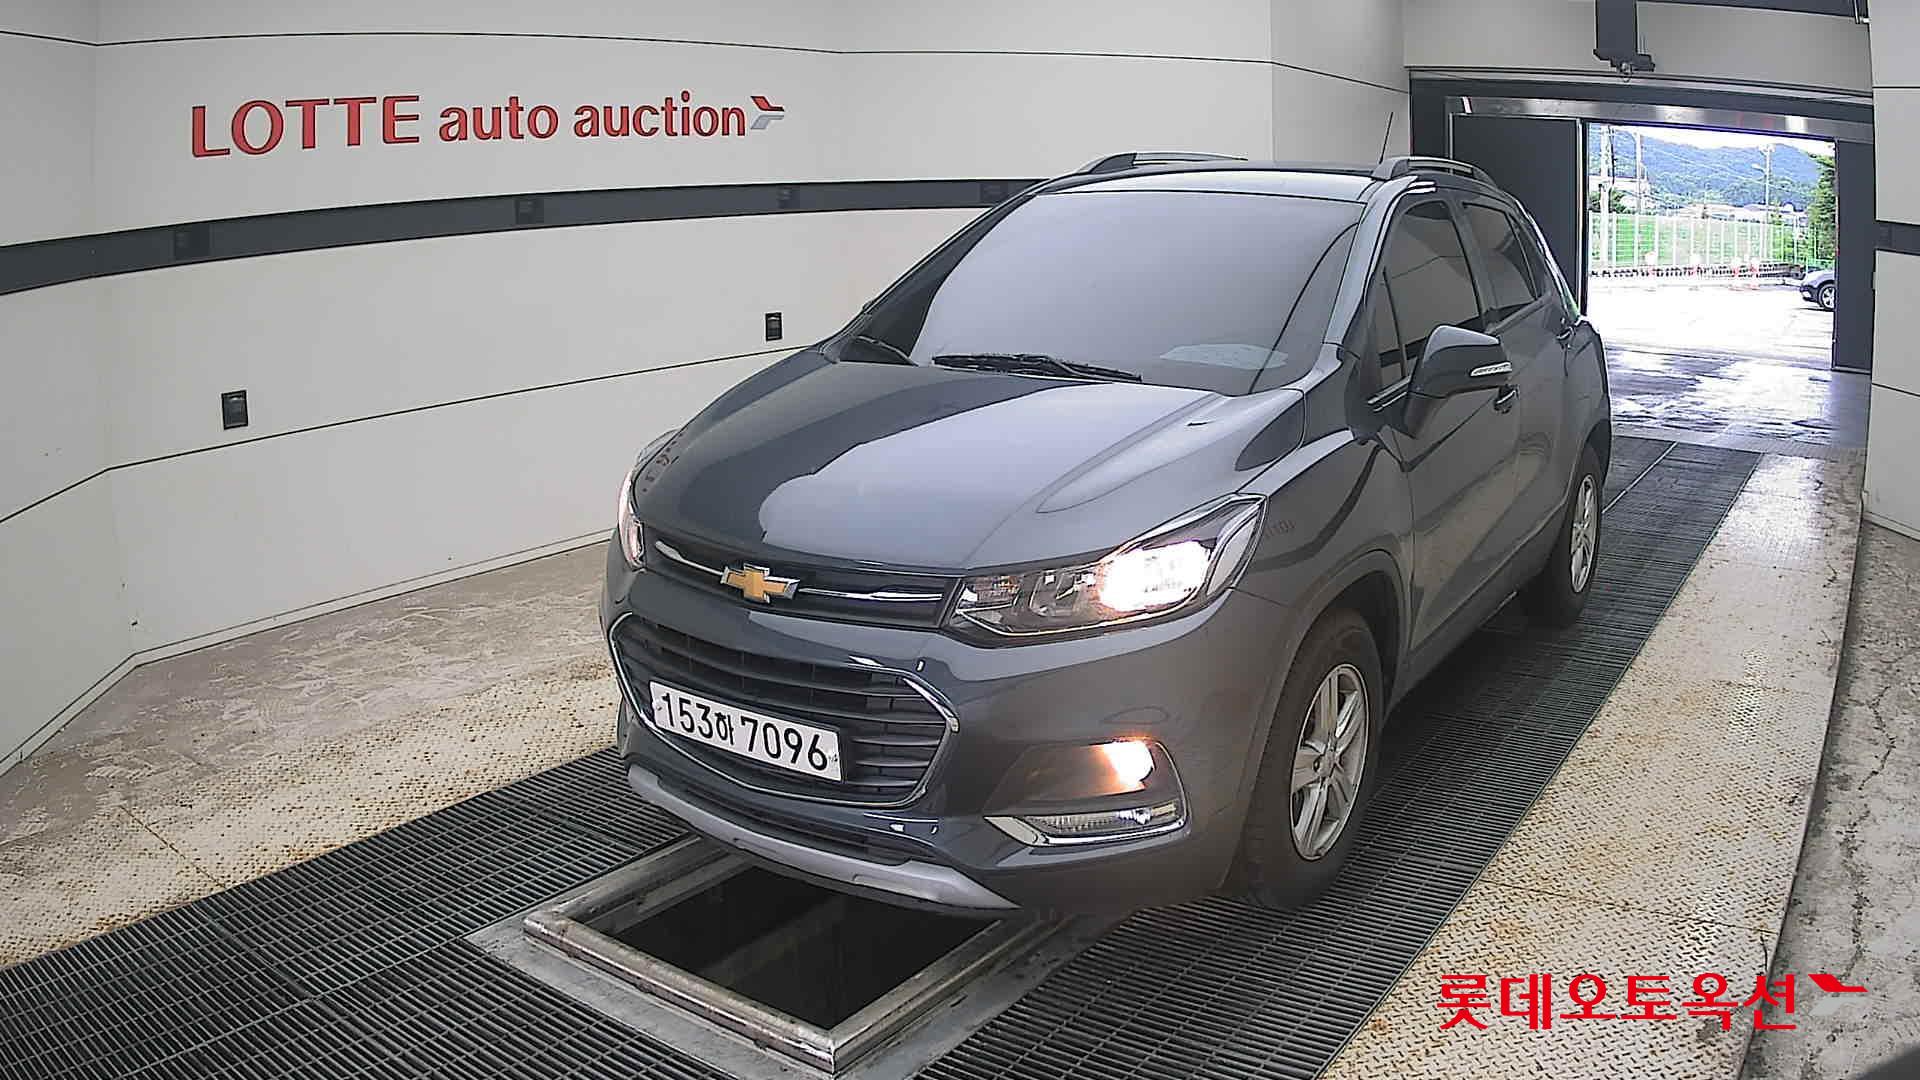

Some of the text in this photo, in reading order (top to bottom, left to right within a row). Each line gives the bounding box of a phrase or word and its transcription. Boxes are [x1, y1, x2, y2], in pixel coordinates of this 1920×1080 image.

[191, 90, 746, 158] LOTTE auto auction
